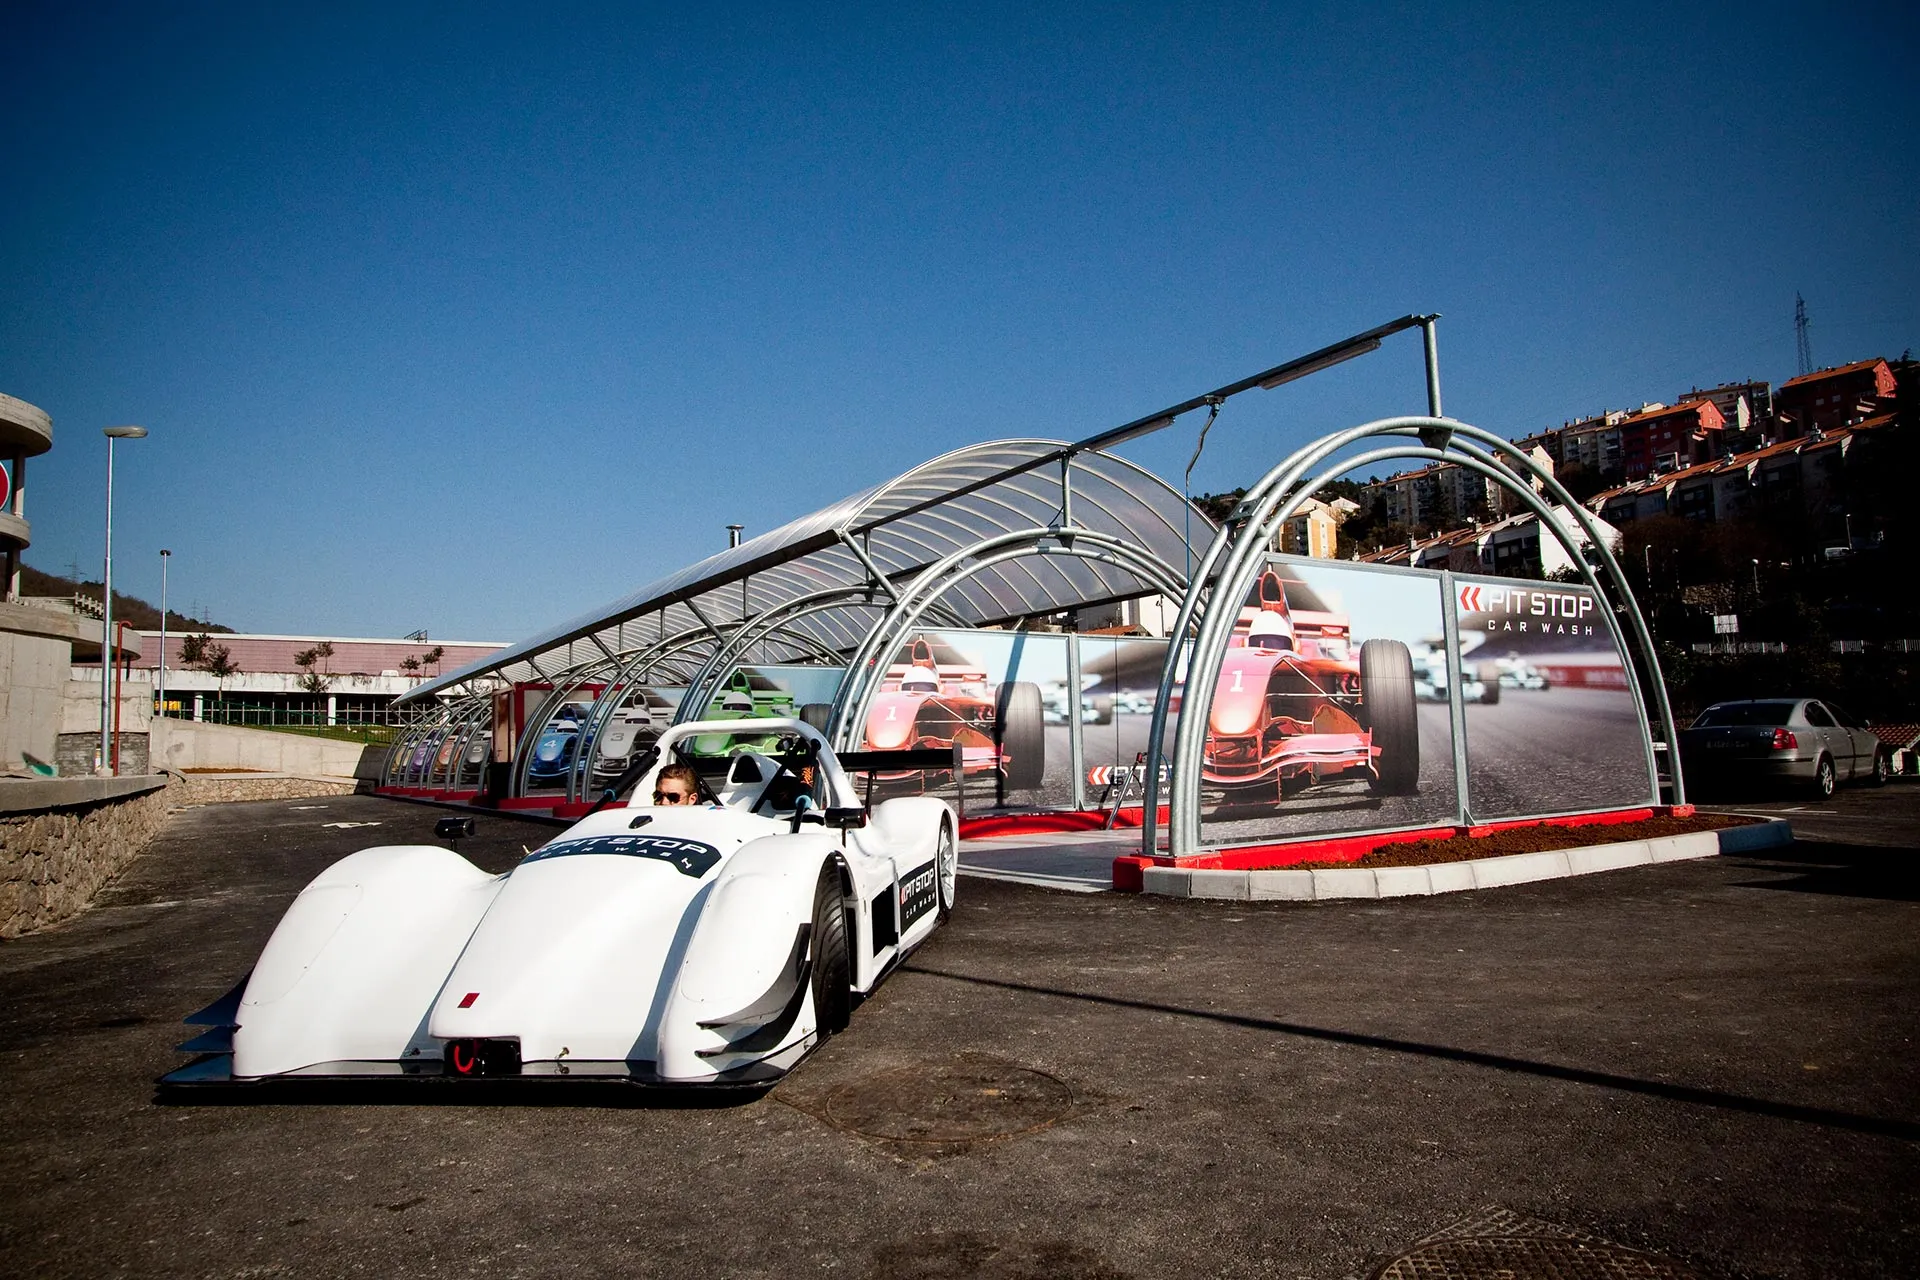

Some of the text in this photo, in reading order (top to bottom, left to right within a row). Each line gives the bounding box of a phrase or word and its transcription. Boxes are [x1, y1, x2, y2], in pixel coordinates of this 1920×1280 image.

[1488, 590, 1593, 619] PIT STOP
[1488, 619, 1593, 636] CAR WASH
[1230, 669, 1244, 693] 1
[885, 705, 897, 721] 1
[543, 739, 557, 749] 4
[610, 732, 625, 742] 3
[607, 837, 708, 854] STOP
[915, 867, 934, 892] STOP
